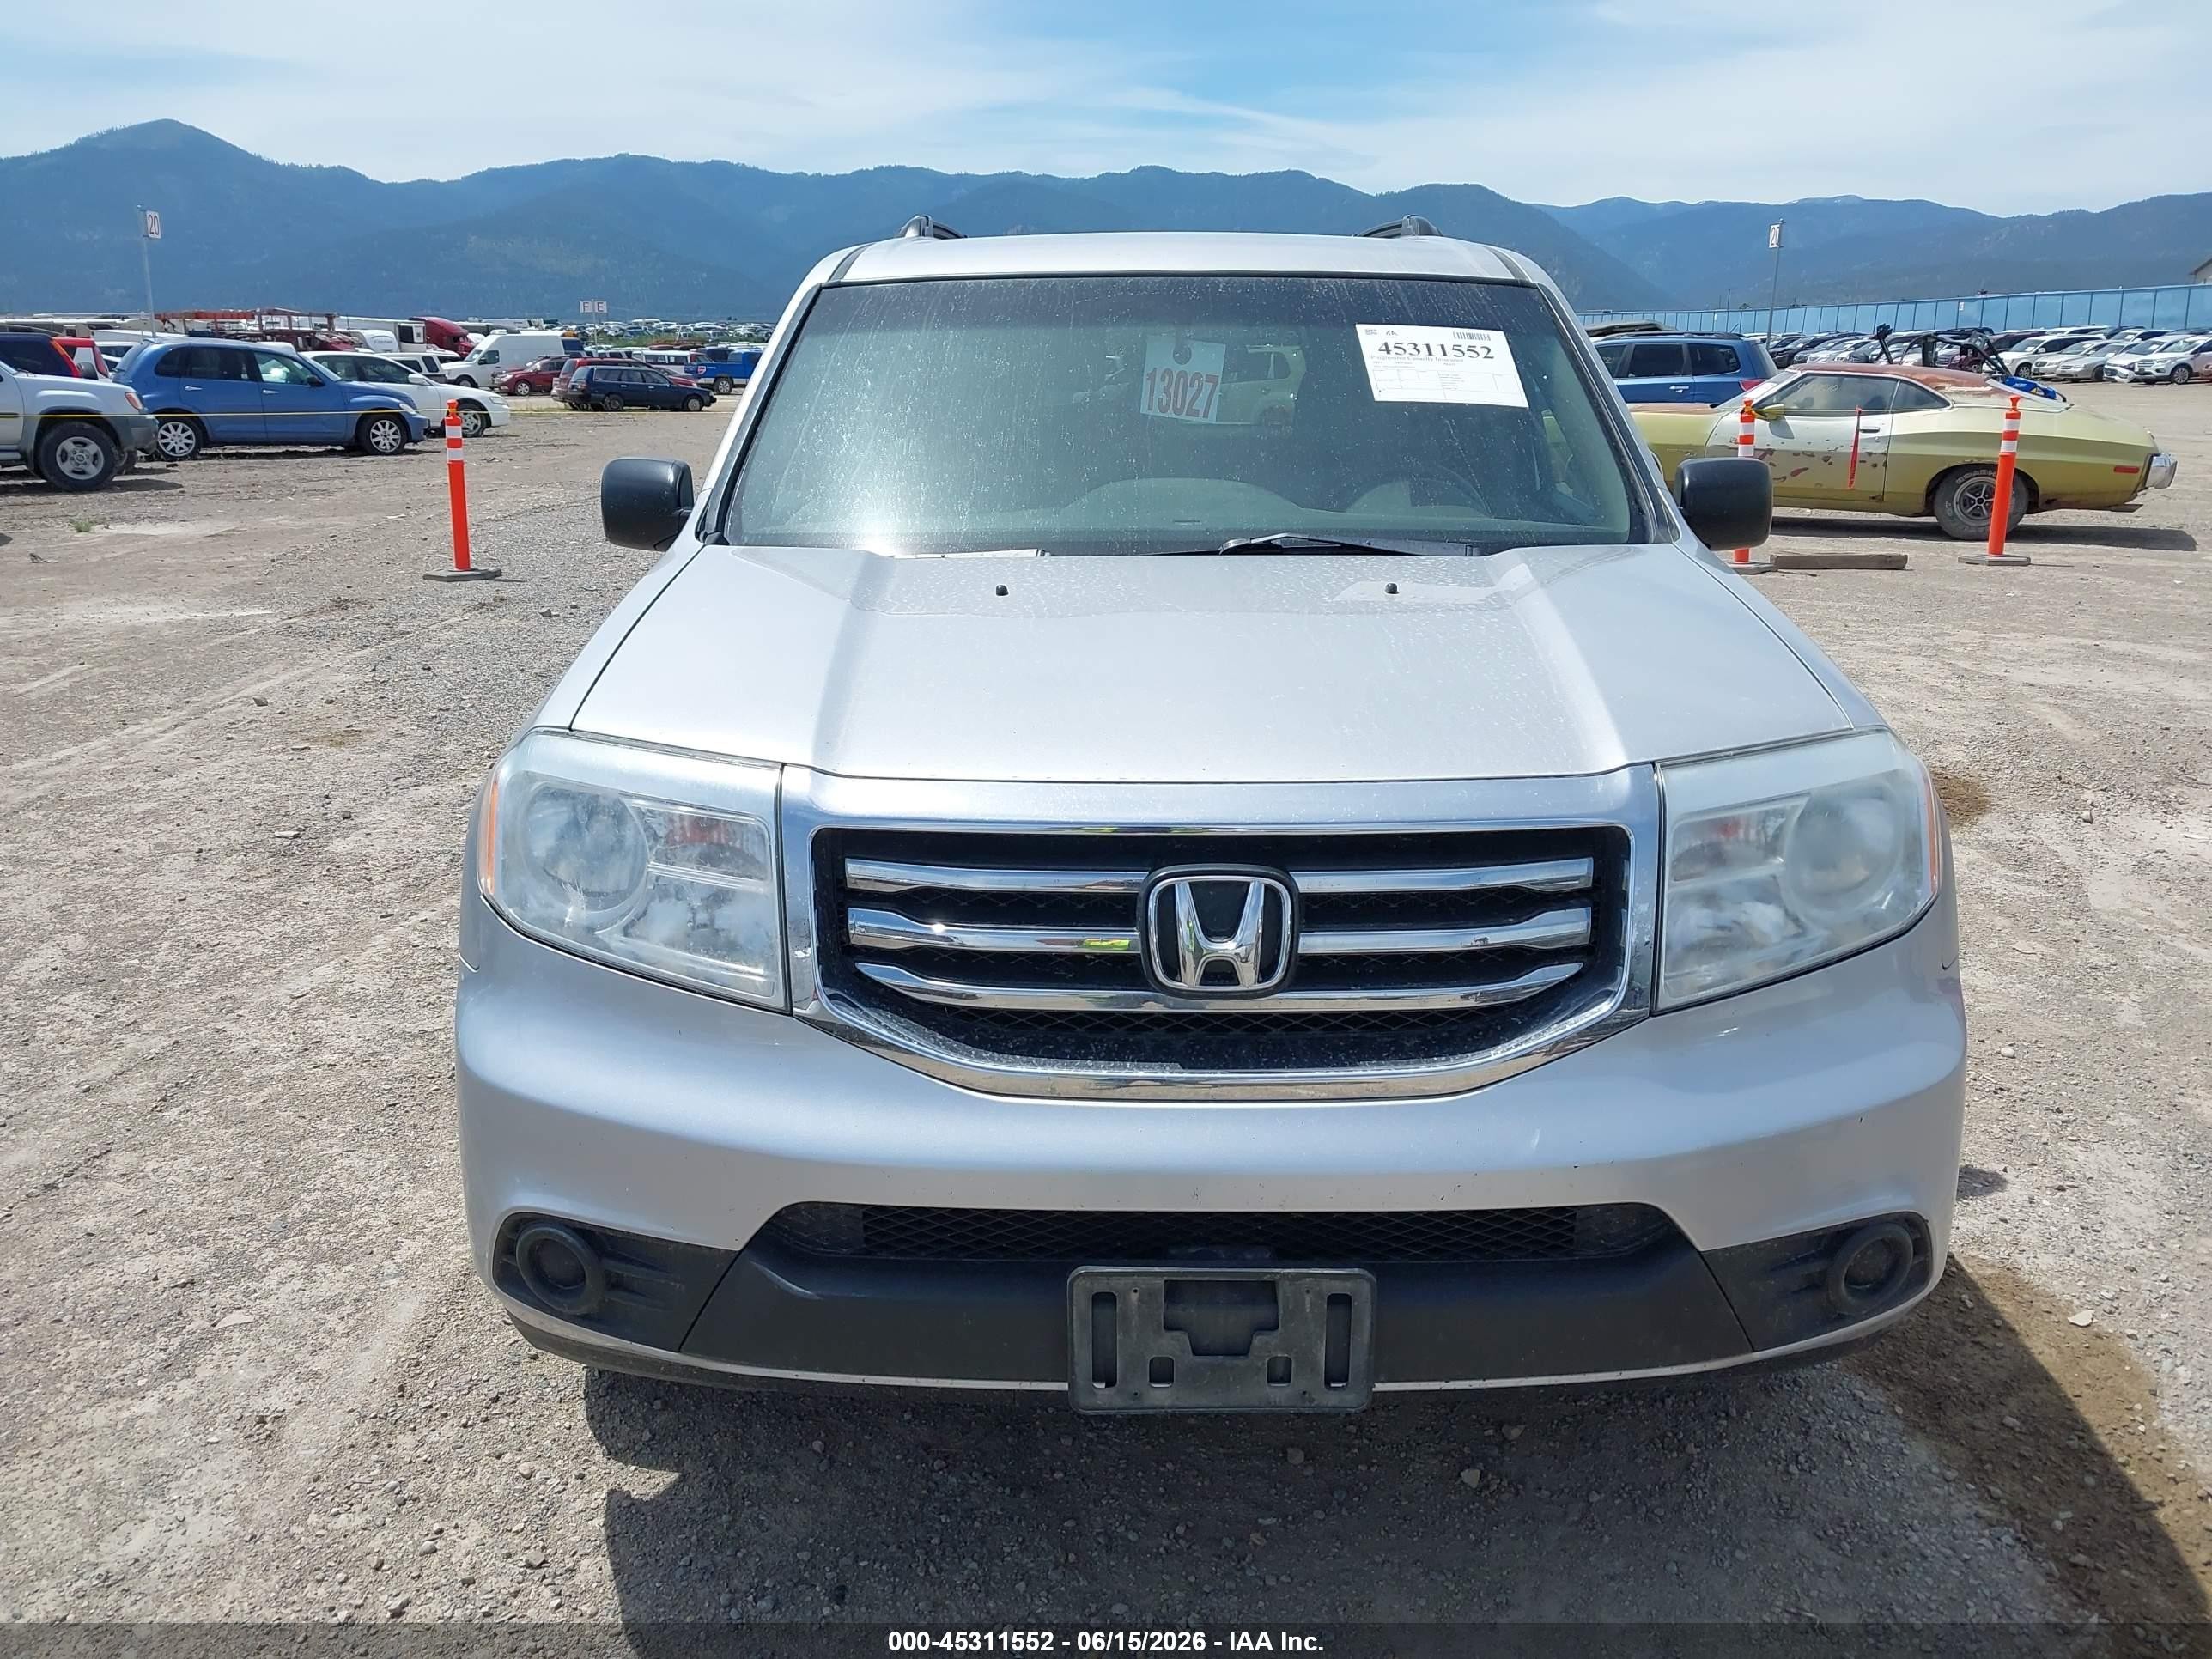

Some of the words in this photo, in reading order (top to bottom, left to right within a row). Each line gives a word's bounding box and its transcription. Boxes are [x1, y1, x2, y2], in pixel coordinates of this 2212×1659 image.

[149, 215, 160, 235] 20
[583, 301, 590, 312] F
[597, 301, 605, 312] E
[1378, 341, 1495, 360] 45311552
[1146, 367, 1219, 419] 13027
